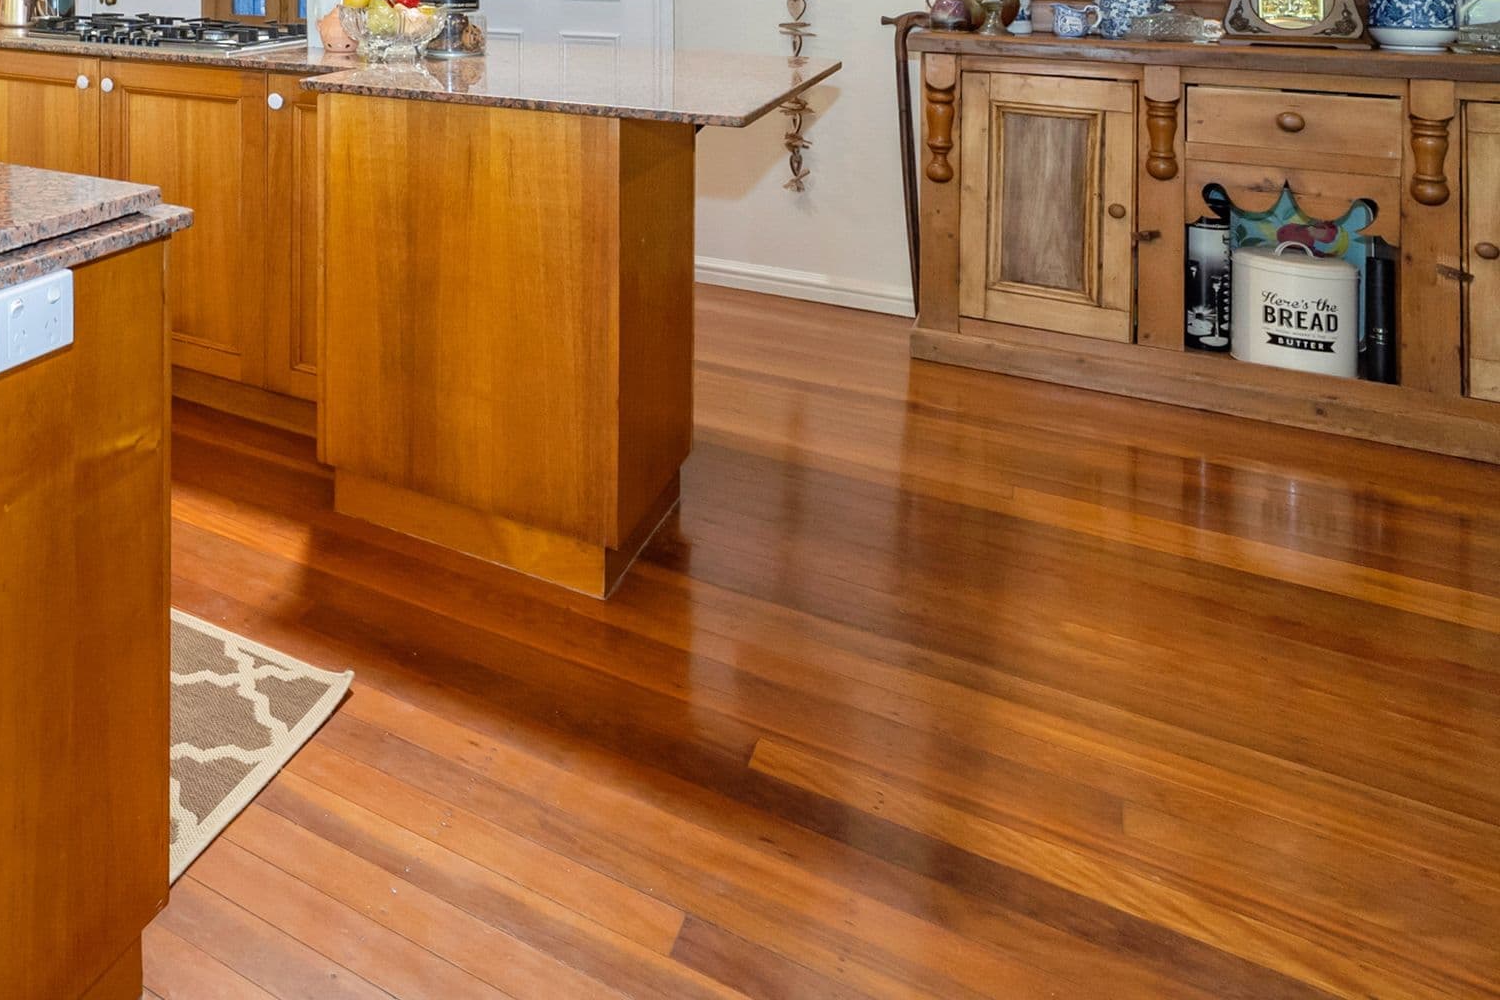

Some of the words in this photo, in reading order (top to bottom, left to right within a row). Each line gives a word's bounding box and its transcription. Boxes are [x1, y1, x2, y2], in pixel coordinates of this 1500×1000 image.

[1261, 290, 1309, 310] Here's
[1310, 298, 1339, 313] the
[1263, 305, 1338, 333] BREAD
[1278, 336, 1324, 351] BUTTER
